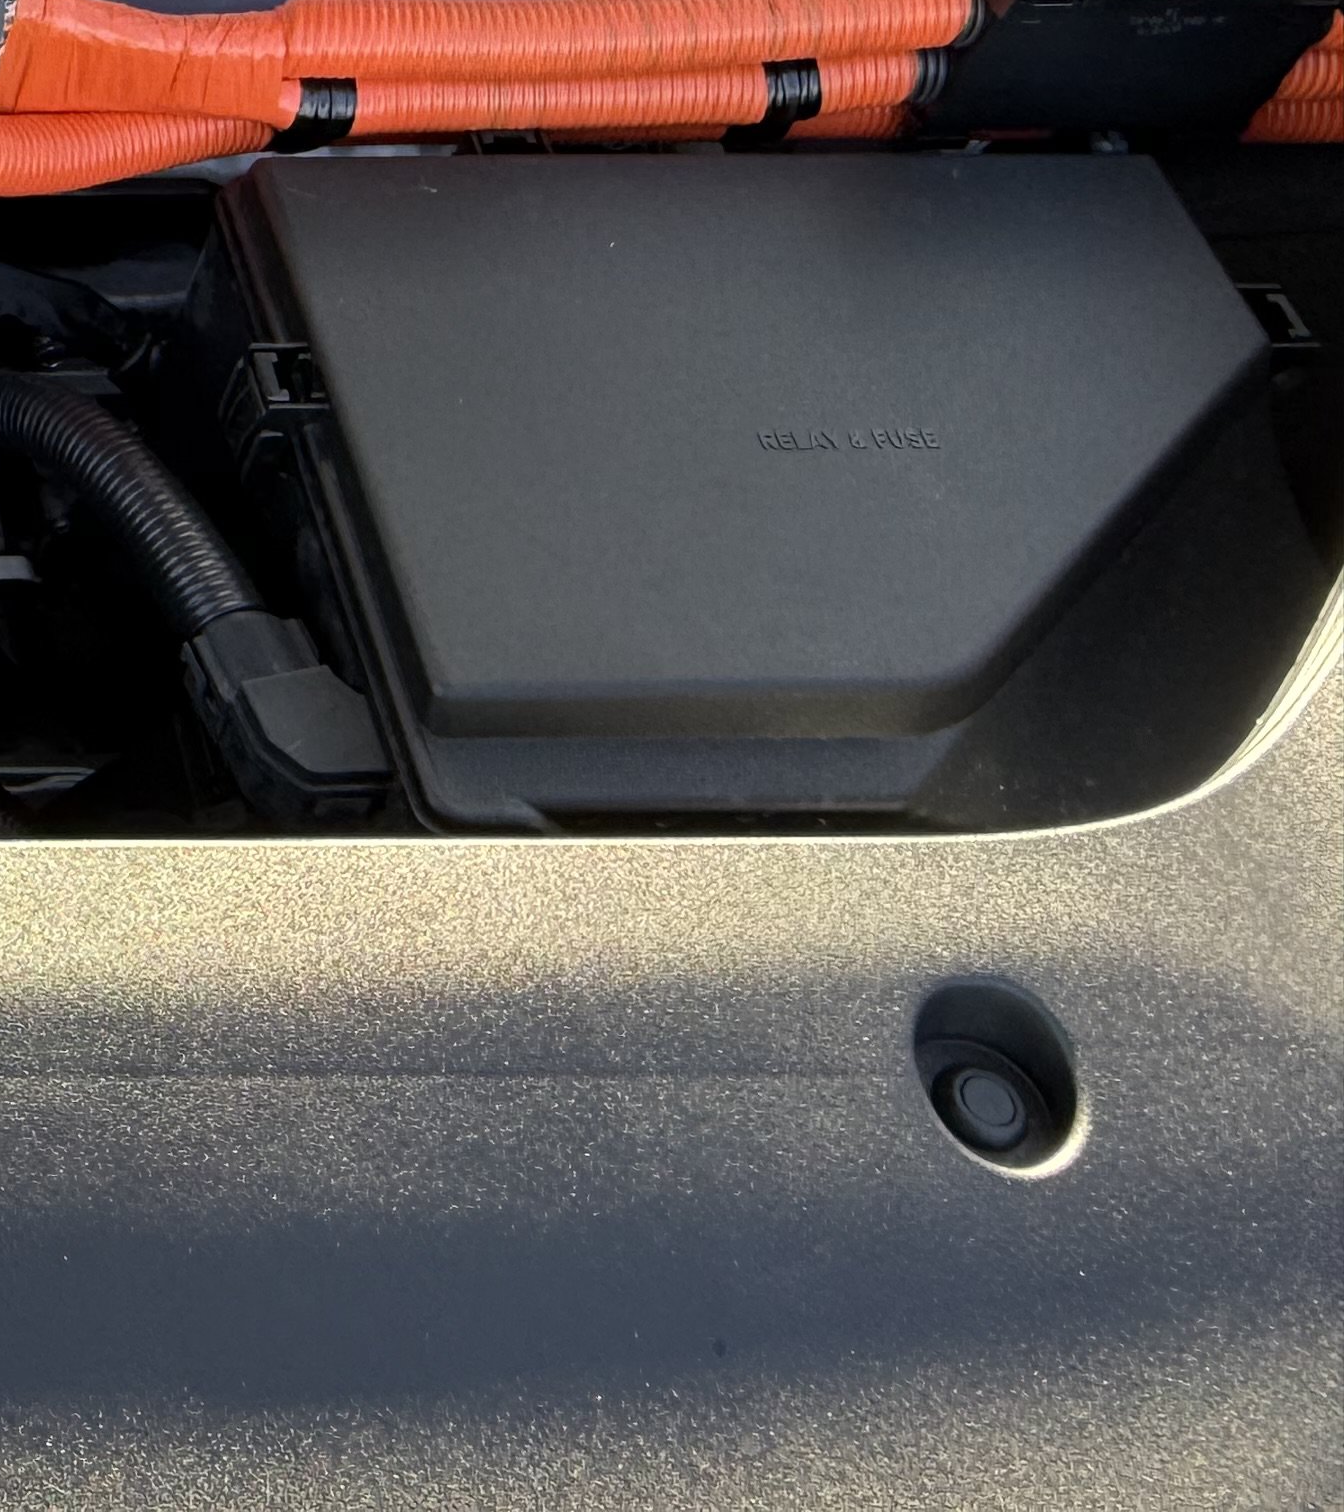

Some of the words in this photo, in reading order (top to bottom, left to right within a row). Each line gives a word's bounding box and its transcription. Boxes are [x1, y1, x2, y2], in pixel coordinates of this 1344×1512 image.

[757, 430, 840, 450] RELAY
[847, 429, 868, 450] &
[870, 427, 942, 450] FUSE
